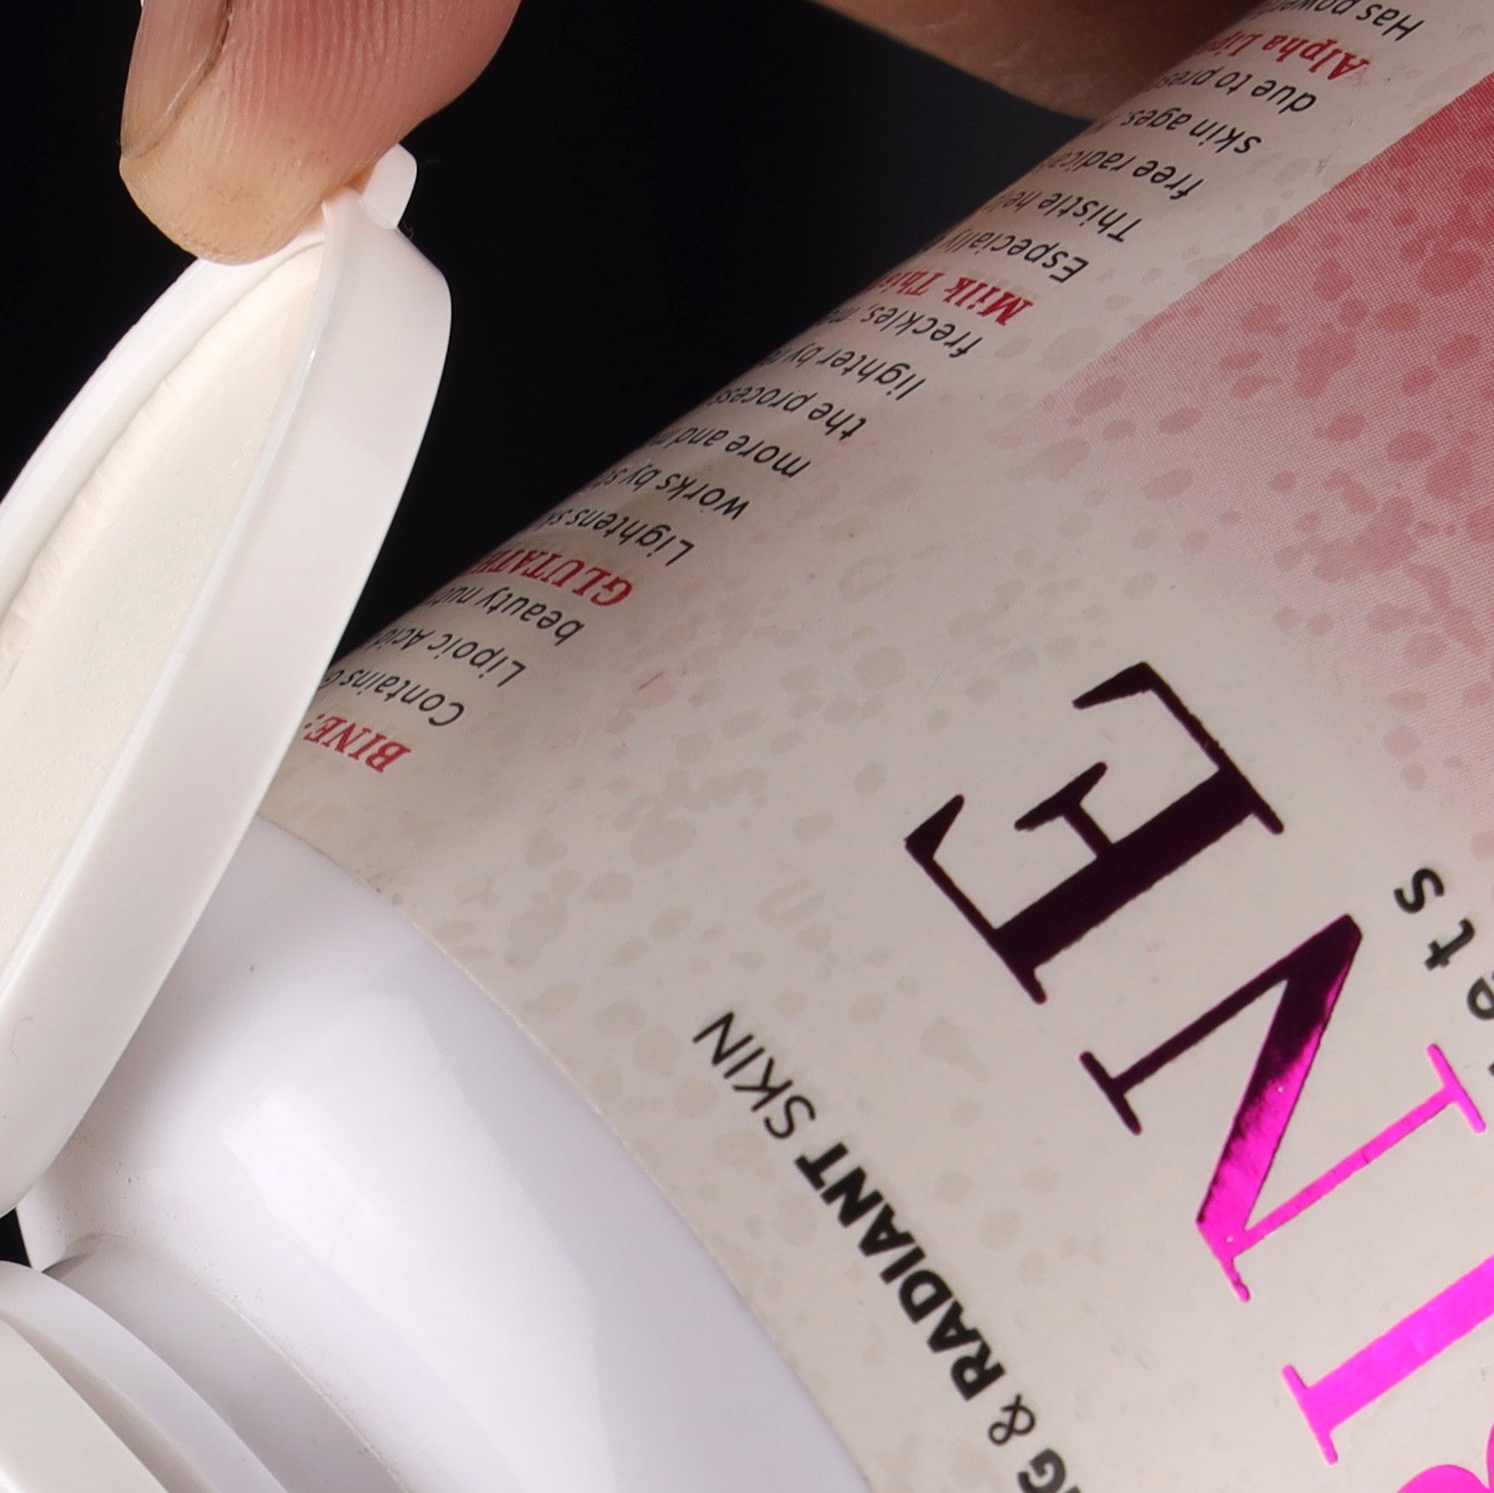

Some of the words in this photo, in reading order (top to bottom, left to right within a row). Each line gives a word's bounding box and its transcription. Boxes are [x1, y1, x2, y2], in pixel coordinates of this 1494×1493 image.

[1355, 3, 1425, 42] Has
[1262, 34, 1370, 81] Alpha
[1214, 71, 1253, 96] to
[1250, 79, 1318, 115] due
[1189, 118, 1262, 155] skin
[1131, 160, 1203, 201] free
[1037, 191, 1143, 243] Thistle
[945, 227, 1090, 284] Especially
[942, 276, 1035, 327] Milk
[817, 348, 927, 402] lighter
[663, 427, 729, 450] and
[808, 402, 868, 441] the
[619, 464, 663, 493] by
[724, 434, 811, 479] more
[655, 473, 750, 521] works
[565, 508, 696, 568] Lightens
[475, 585, 587, 647] beauty
[427, 632, 528, 688] Lipoic
[339, 669, 466, 728] Contains
[303, 713, 413, 774] BINE:
[692, 1010, 818, 1141] SKIN
[794, 1140, 1006, 1400] RADIANT
[987, 1394, 1037, 1447] &
